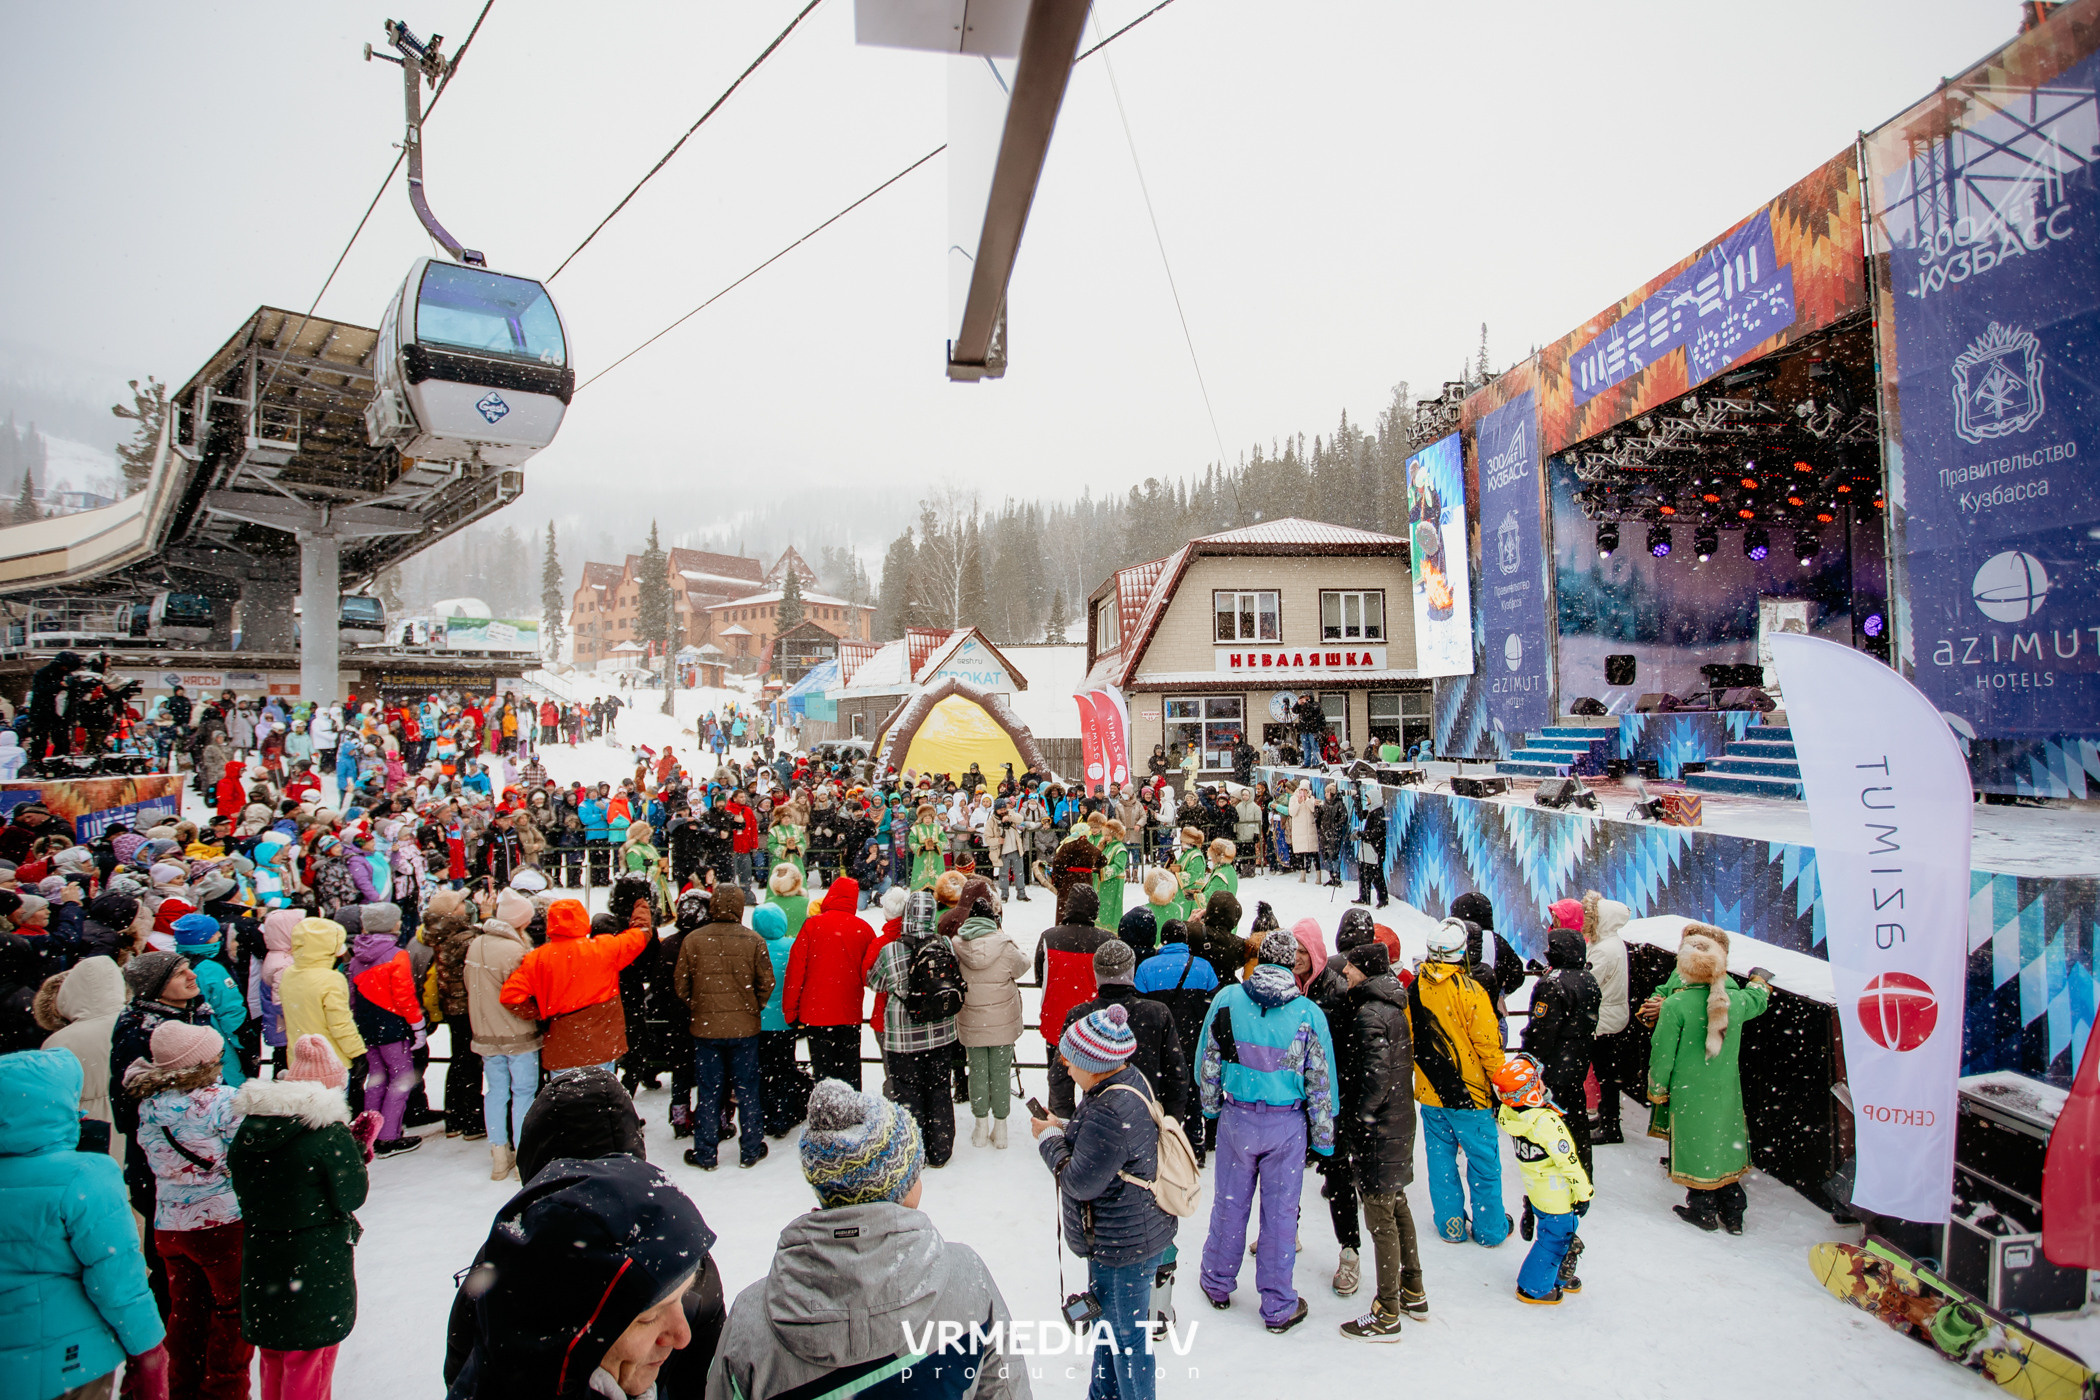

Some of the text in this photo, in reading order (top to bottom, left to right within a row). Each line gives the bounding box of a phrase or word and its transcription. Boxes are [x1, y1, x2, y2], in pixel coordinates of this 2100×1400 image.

[1918, 216, 1976, 266] 300
[1918, 204, 2074, 299] КУЗБАСС
[540, 348, 565, 366] 46
[1487, 453, 1505, 475] 300
[1487, 459, 1529, 493] КУЗБАСС
[1939, 441, 2077, 489] Правительство
[1960, 480, 2049, 514] Кузбасса
[1230, 652, 1374, 668] НЕВАЛЯШКА
[183, 675, 221, 686] КАССЫ
[1976, 671, 2055, 689] HOTELS
[1513, 1135, 1544, 1160] USA
